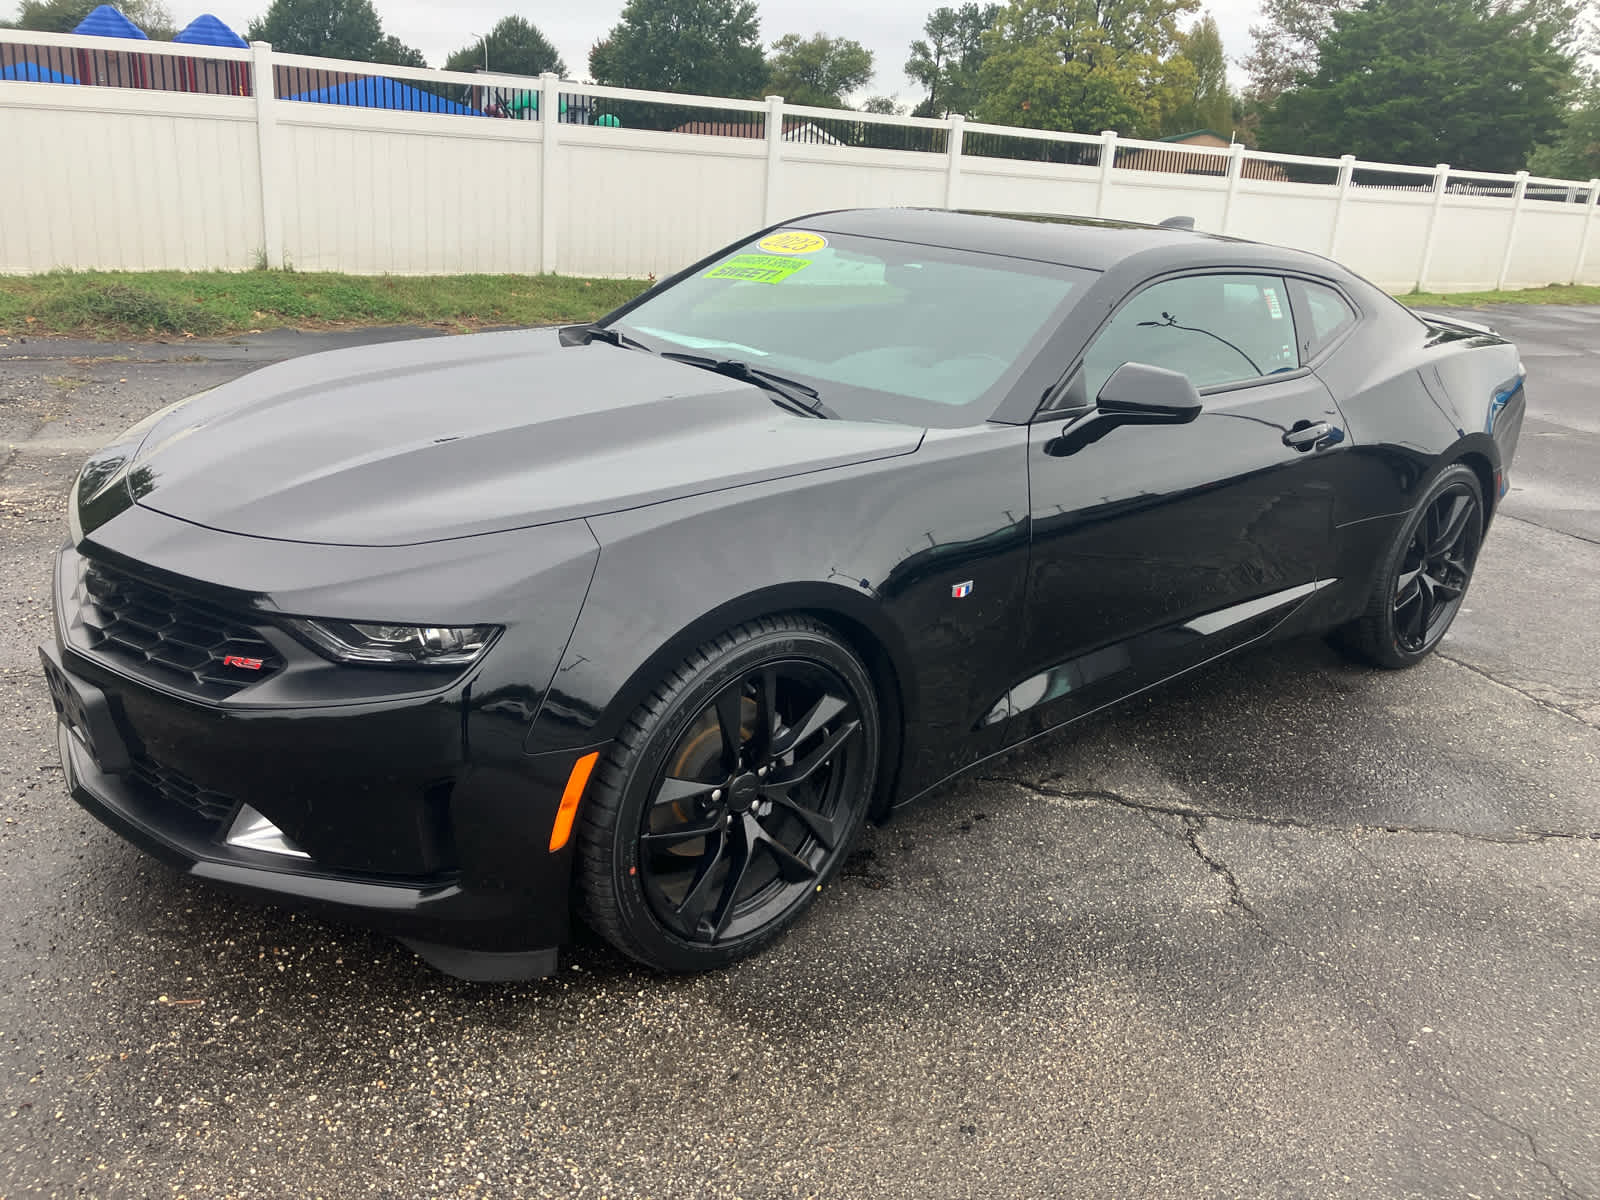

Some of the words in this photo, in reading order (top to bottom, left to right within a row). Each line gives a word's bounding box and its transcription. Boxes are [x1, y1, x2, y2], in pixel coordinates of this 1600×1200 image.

[762, 235, 821, 250] 2023
[711, 265, 783, 281] SWEET!
[223, 655, 264, 670] RS
